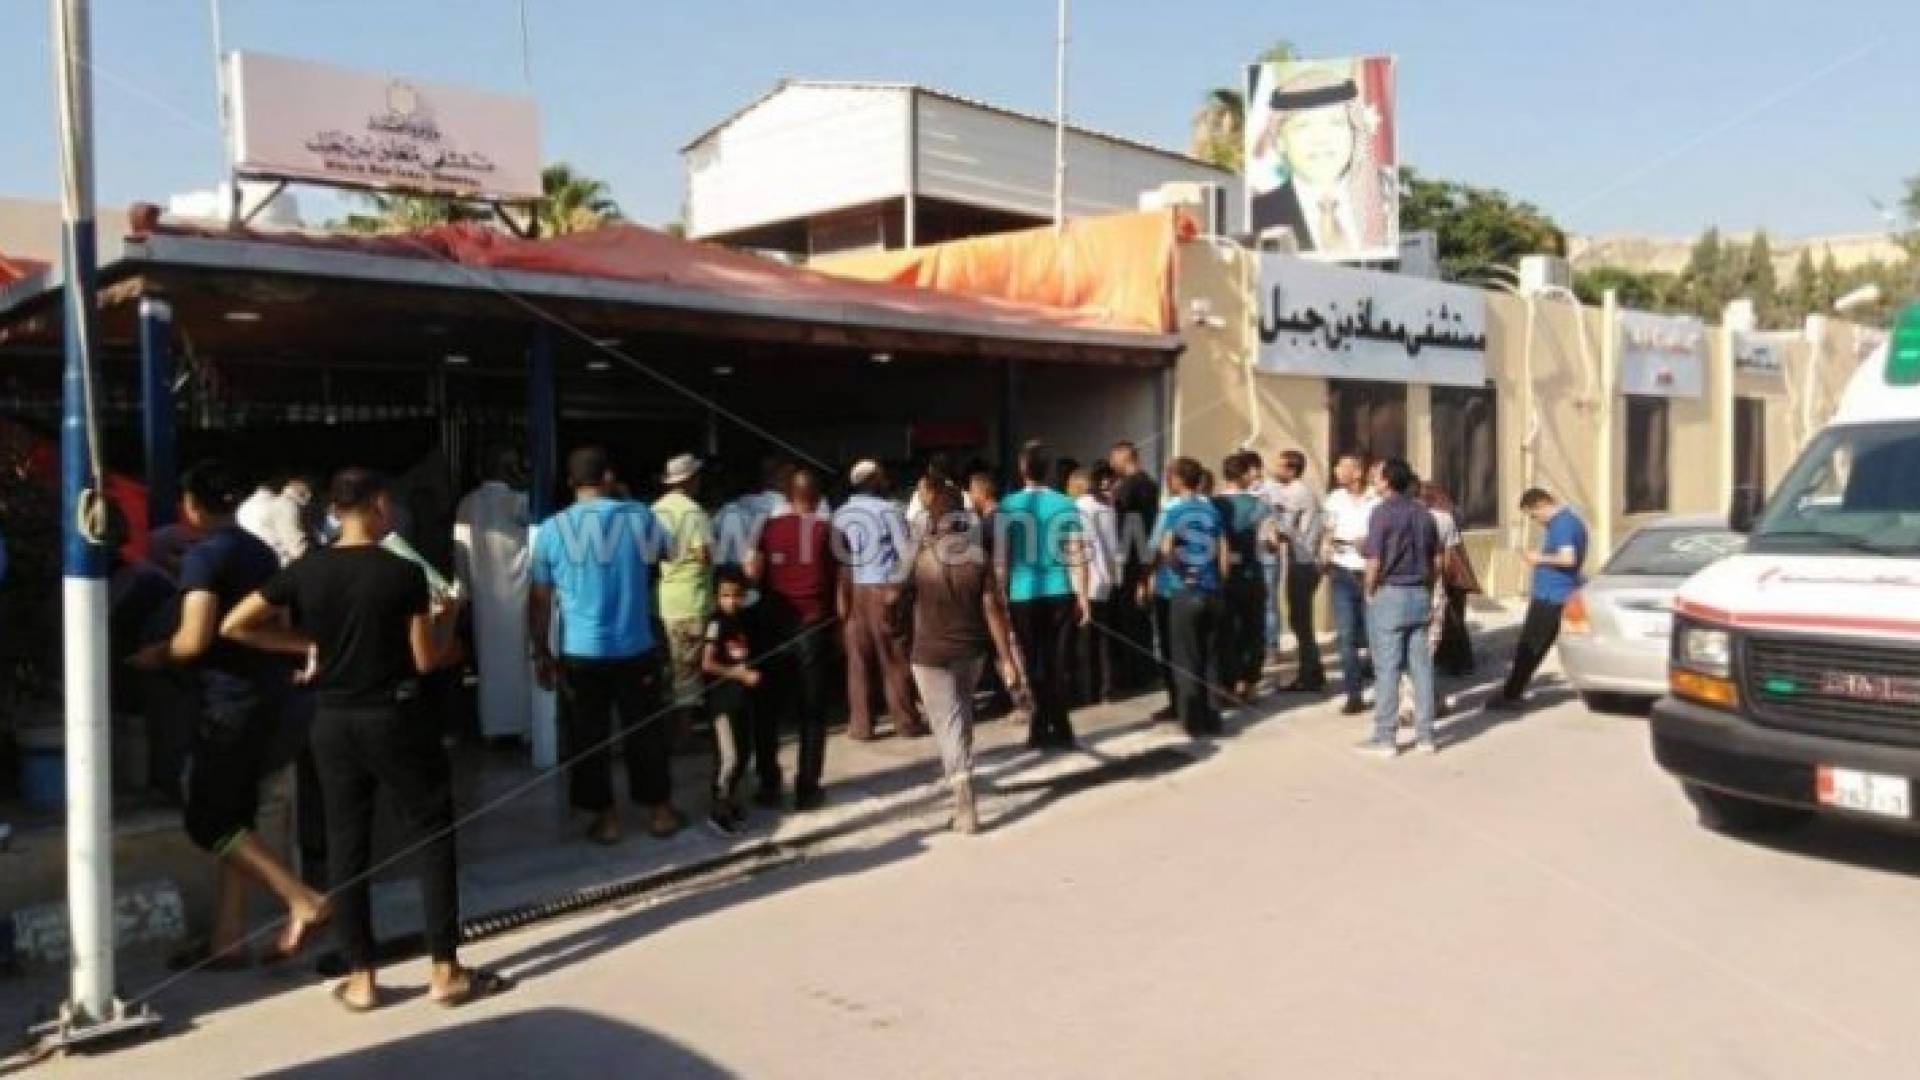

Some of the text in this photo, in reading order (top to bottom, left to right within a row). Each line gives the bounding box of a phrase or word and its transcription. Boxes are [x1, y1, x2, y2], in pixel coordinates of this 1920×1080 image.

[1258, 284, 1486, 359] مستشفى معاذ بن جبل
